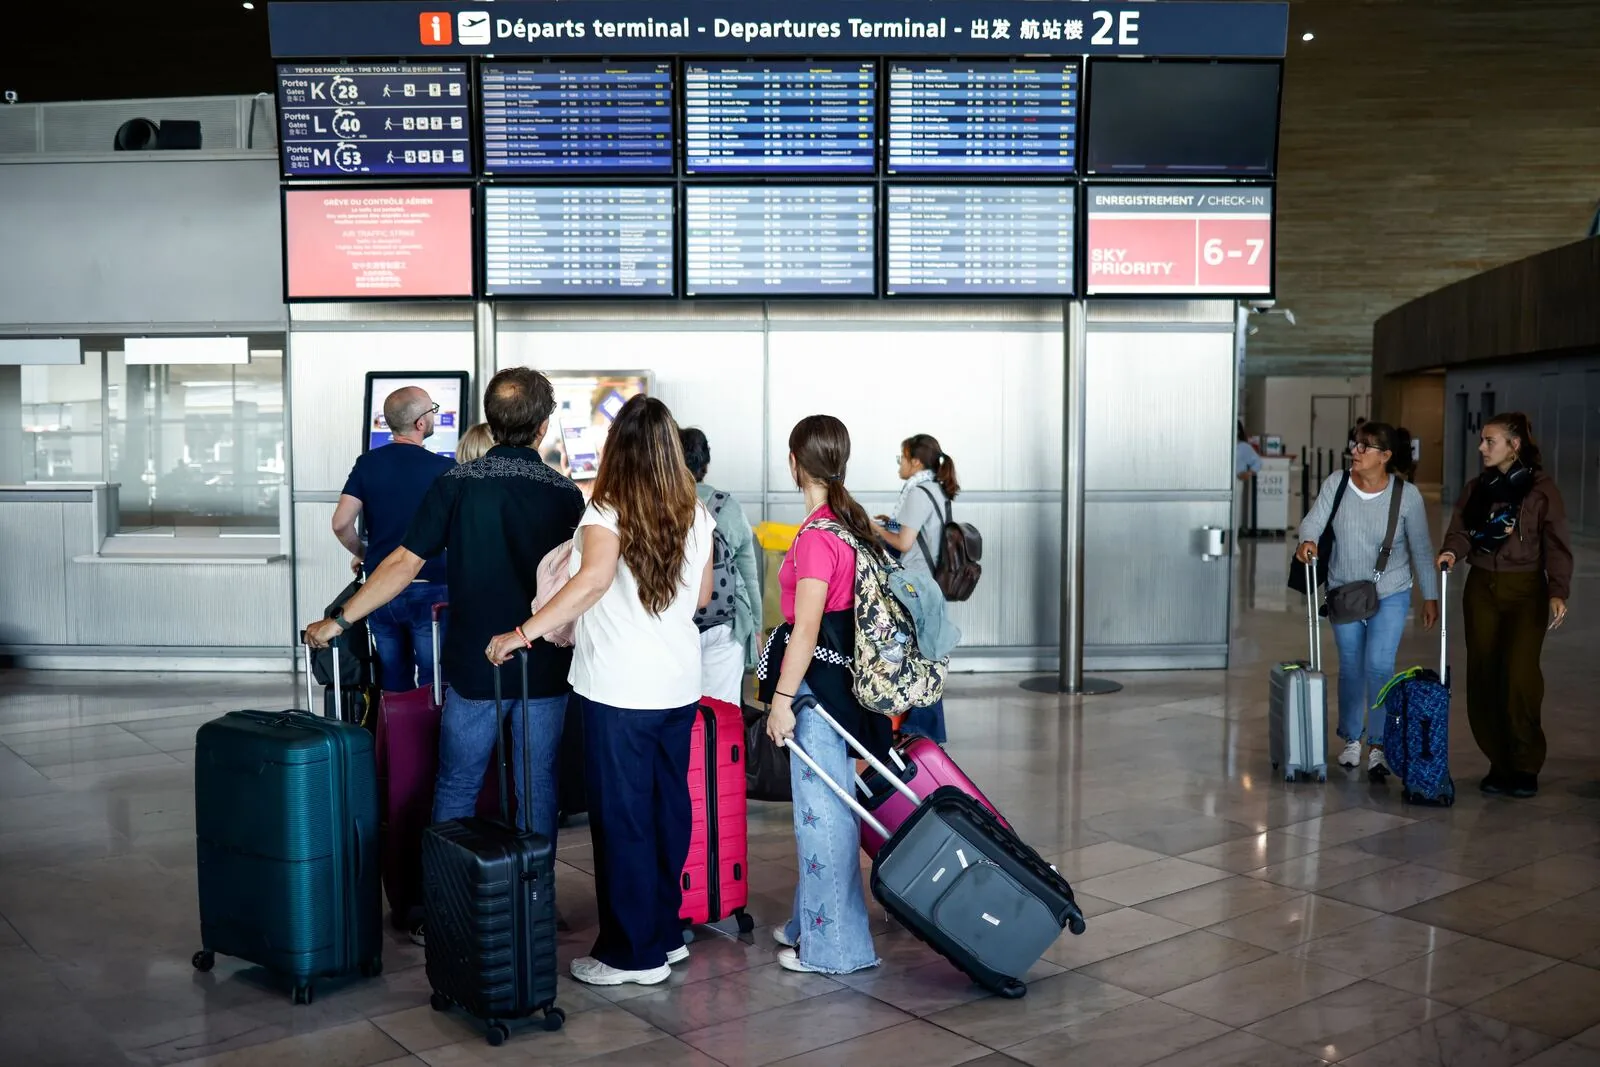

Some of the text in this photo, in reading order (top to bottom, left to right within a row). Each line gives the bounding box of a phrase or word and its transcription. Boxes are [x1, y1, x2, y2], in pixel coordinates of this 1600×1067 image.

[496, 18, 586, 43] Départs
[592, 17, 690, 38] terminal
[714, 18, 841, 43] Departures
[848, 17, 947, 38] Terminal
[970, 19, 1011, 40] 出发
[1020, 19, 1084, 40] 航站楼
[1090, 10, 1141, 46] 2E
[310, 82, 326, 100] K
[338, 85, 358, 99] 28
[314, 115, 327, 133] L
[340, 118, 361, 132] 40
[313, 148, 331, 166] M
[342, 151, 362, 165] 53
[1095, 195, 1194, 206] ENREGISTREMENT
[1207, 195, 1264, 206] CHECK-IN
[1091, 248, 1127, 262] SKY
[1203, 238, 1265, 266] 6-7
[1091, 262, 1173, 276] PRIORITY
